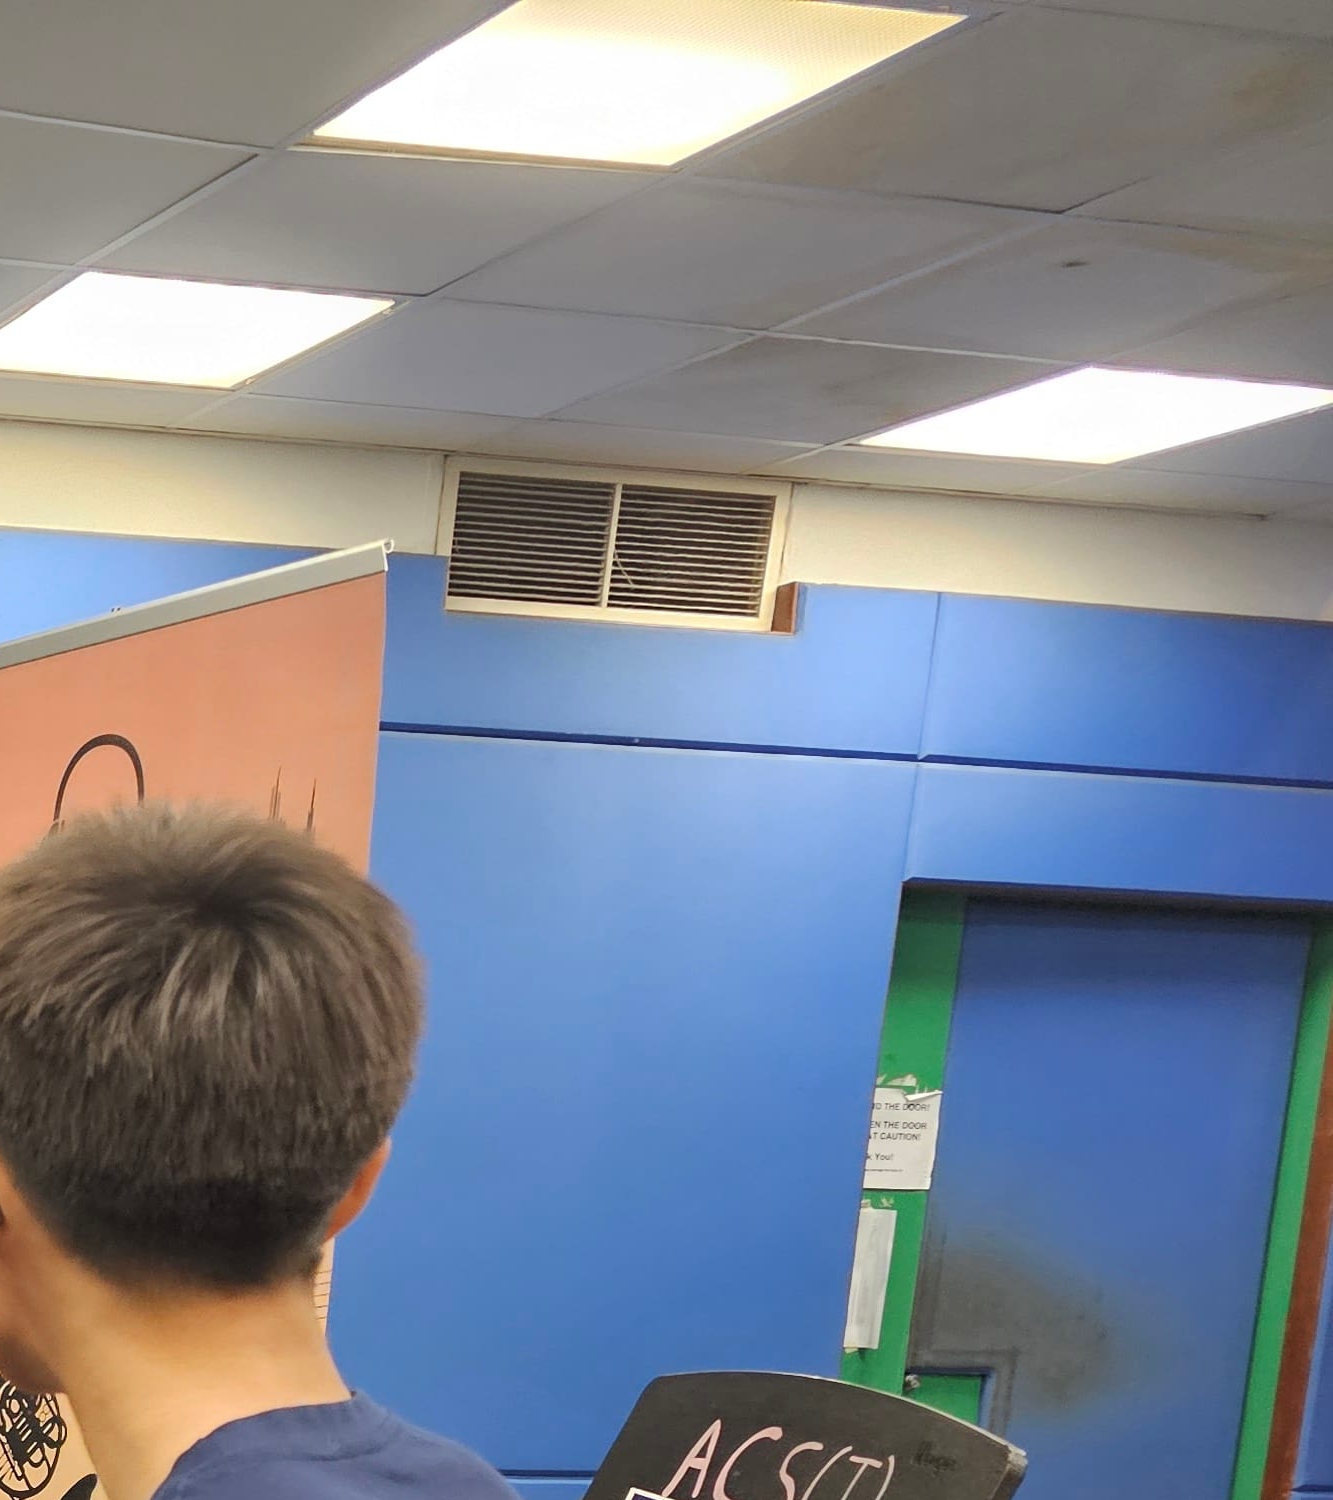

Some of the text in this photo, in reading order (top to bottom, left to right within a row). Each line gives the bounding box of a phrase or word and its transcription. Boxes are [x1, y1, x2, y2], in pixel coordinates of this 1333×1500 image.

[884, 1103, 900, 1111] THE
[883, 1121, 900, 1129] THE
[902, 1121, 927, 1130] DOOR
